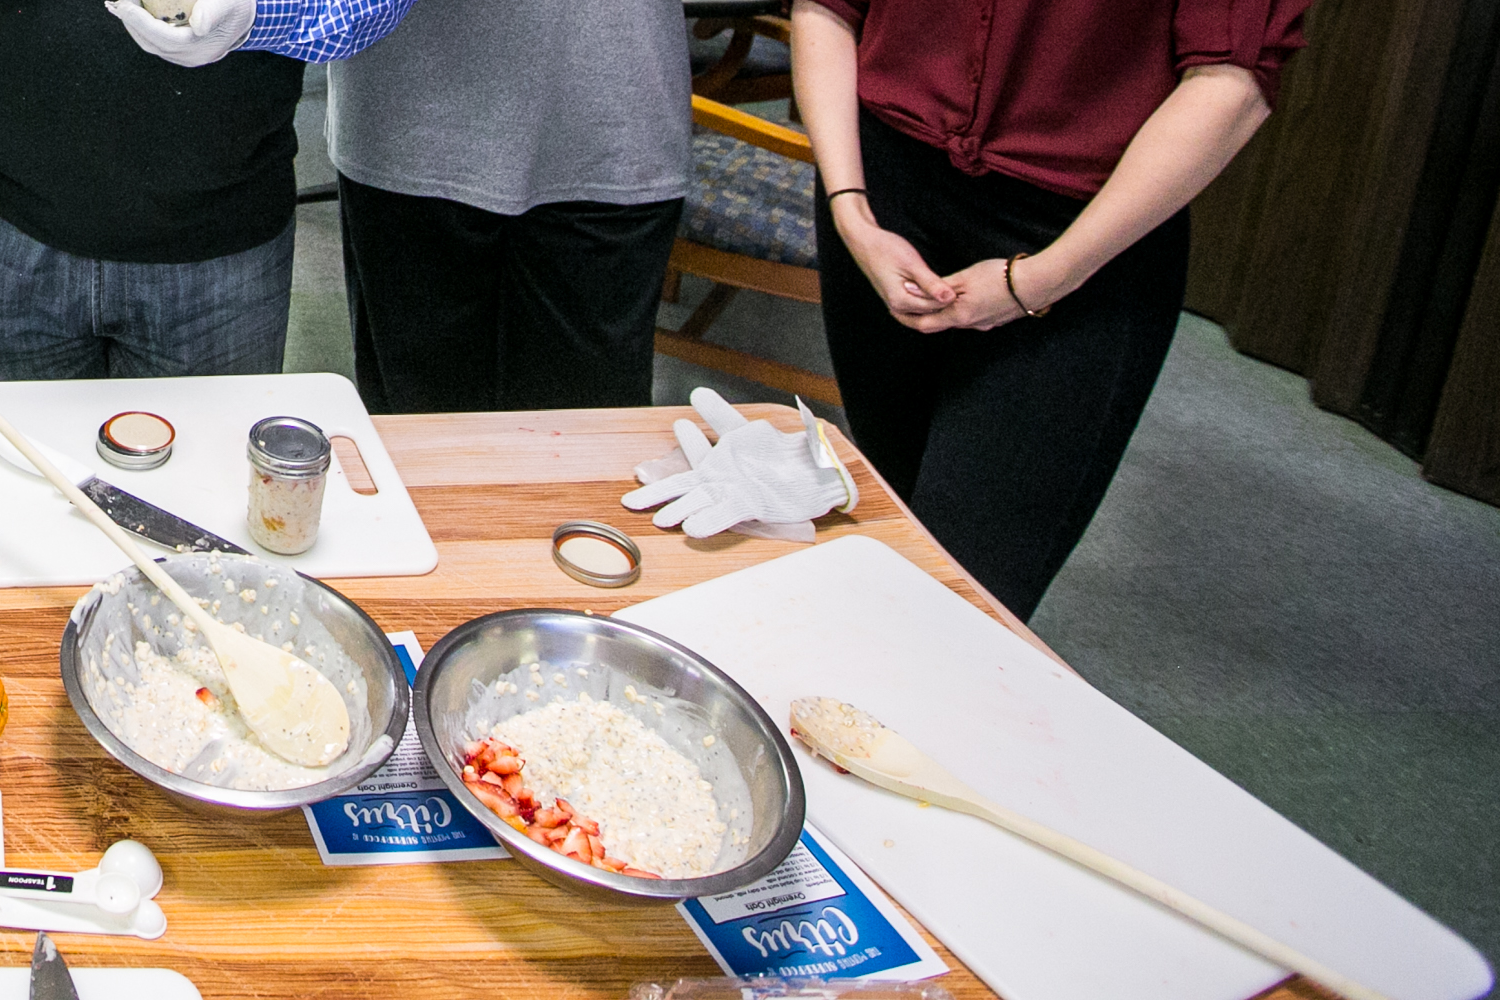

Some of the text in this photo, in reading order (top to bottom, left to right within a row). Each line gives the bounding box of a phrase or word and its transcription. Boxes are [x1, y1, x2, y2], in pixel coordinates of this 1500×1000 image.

[378, 781, 417, 790] Overnight
[344, 798, 450, 832] Citrus
[363, 835, 417, 844] SUPERFOOD
[8, 876, 56, 890] 1 TEASPOON
[745, 892, 805, 910] Overnight Oats
[744, 907, 858, 956] Citrus
